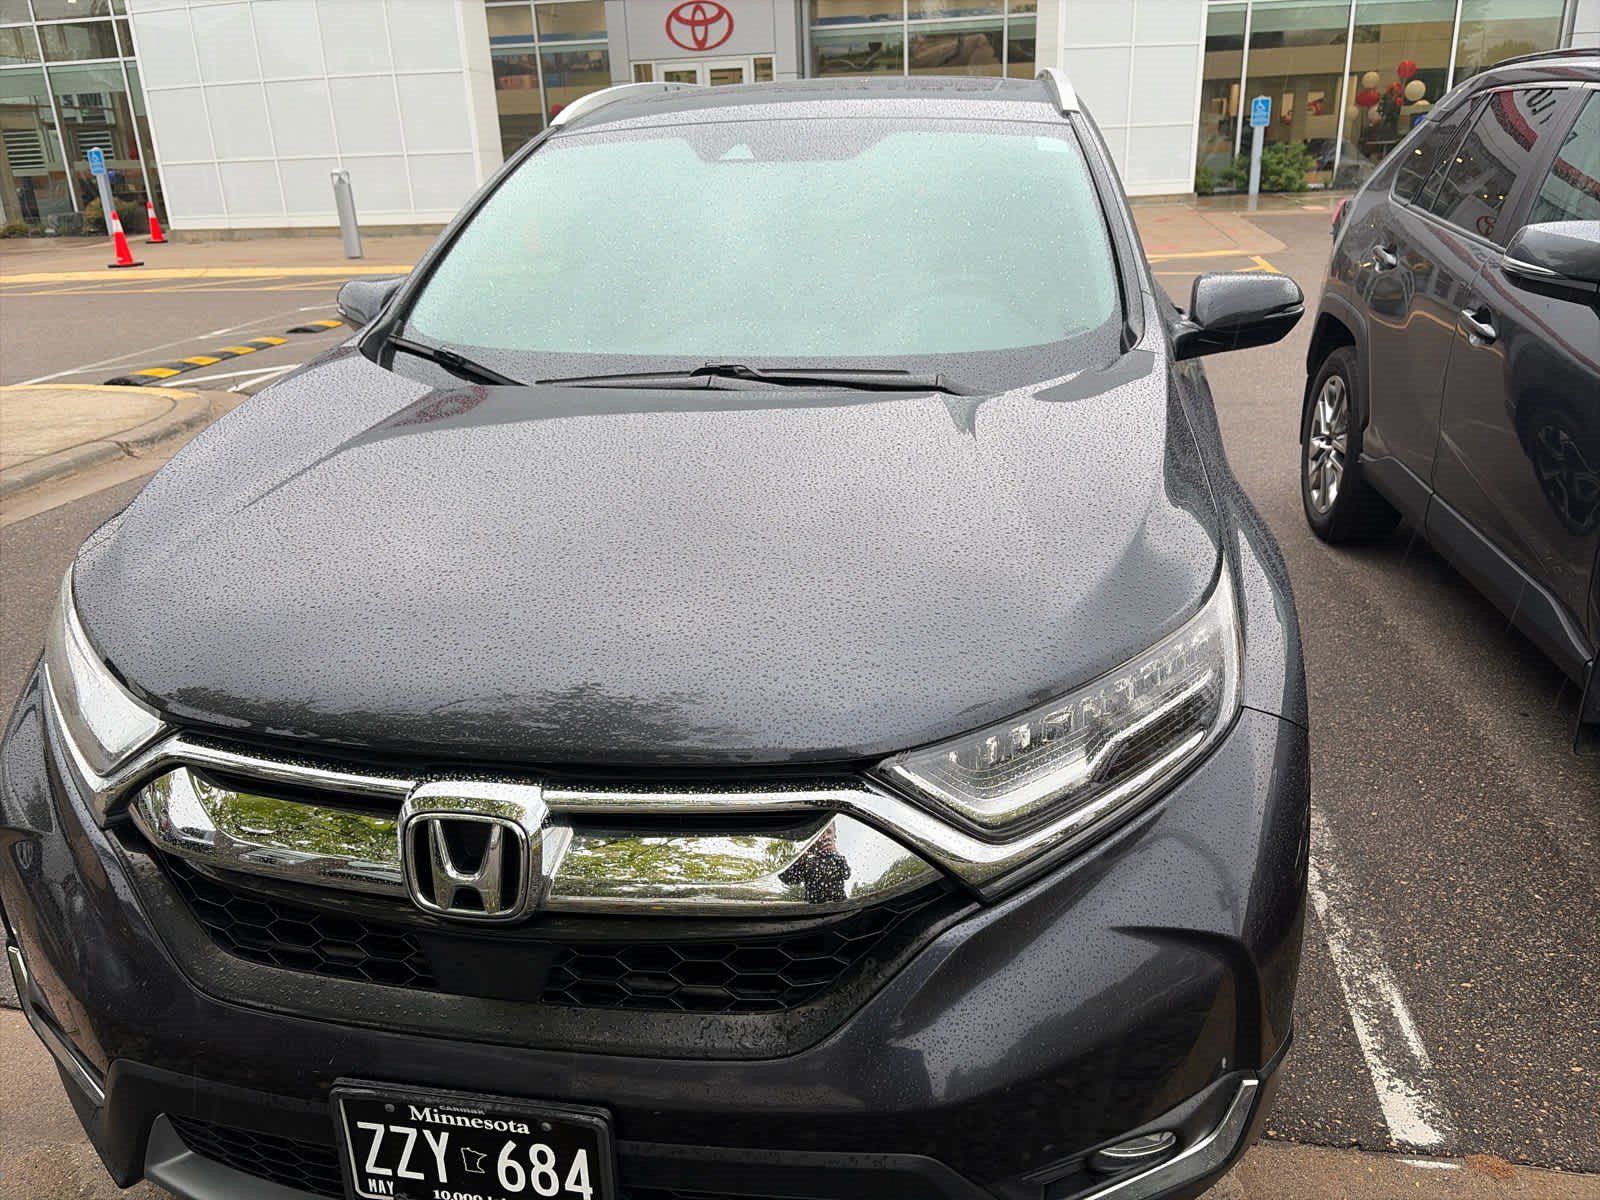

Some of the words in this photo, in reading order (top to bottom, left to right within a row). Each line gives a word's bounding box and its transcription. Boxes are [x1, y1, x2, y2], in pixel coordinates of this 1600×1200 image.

[408, 1105, 530, 1134] Minnesota
[357, 1121, 449, 1183] ZZY
[497, 1140, 593, 1200] 684
[368, 1178, 394, 1195] MAY
